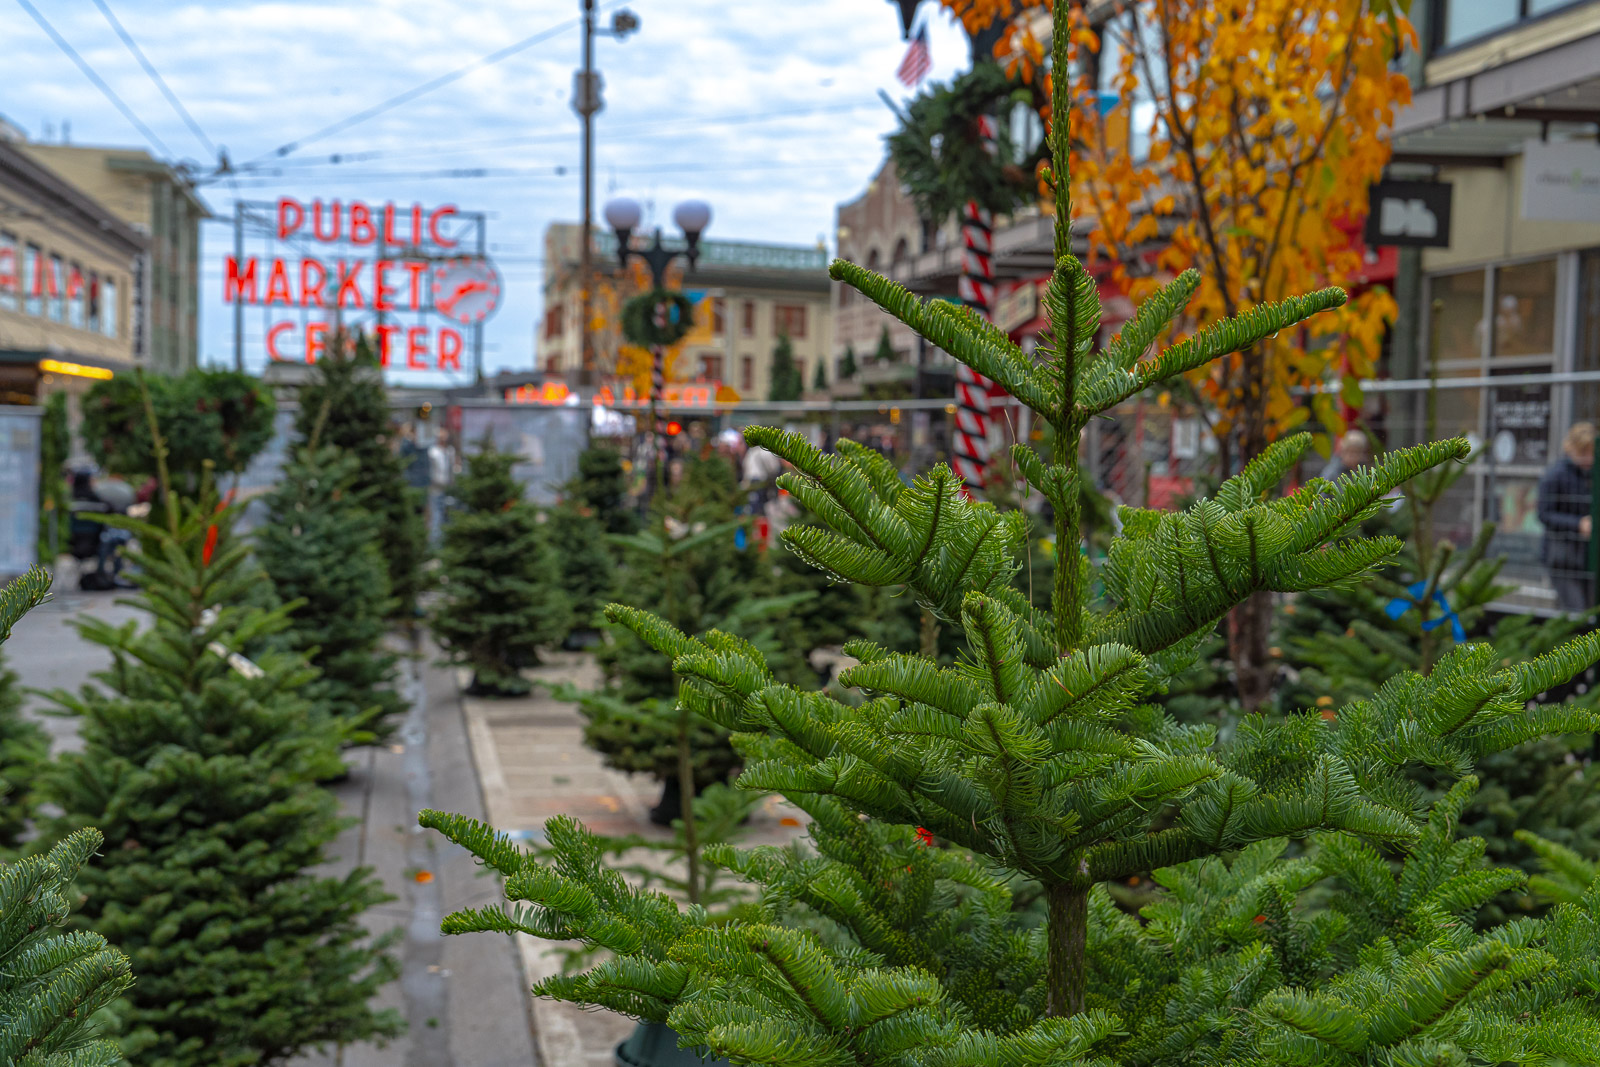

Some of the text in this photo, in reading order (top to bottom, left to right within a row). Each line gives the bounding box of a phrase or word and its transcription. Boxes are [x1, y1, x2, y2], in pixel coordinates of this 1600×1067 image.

[277, 198, 460, 248] PUBLIC
[224, 255, 429, 312] MARKET
[265, 321, 464, 371] CETER
